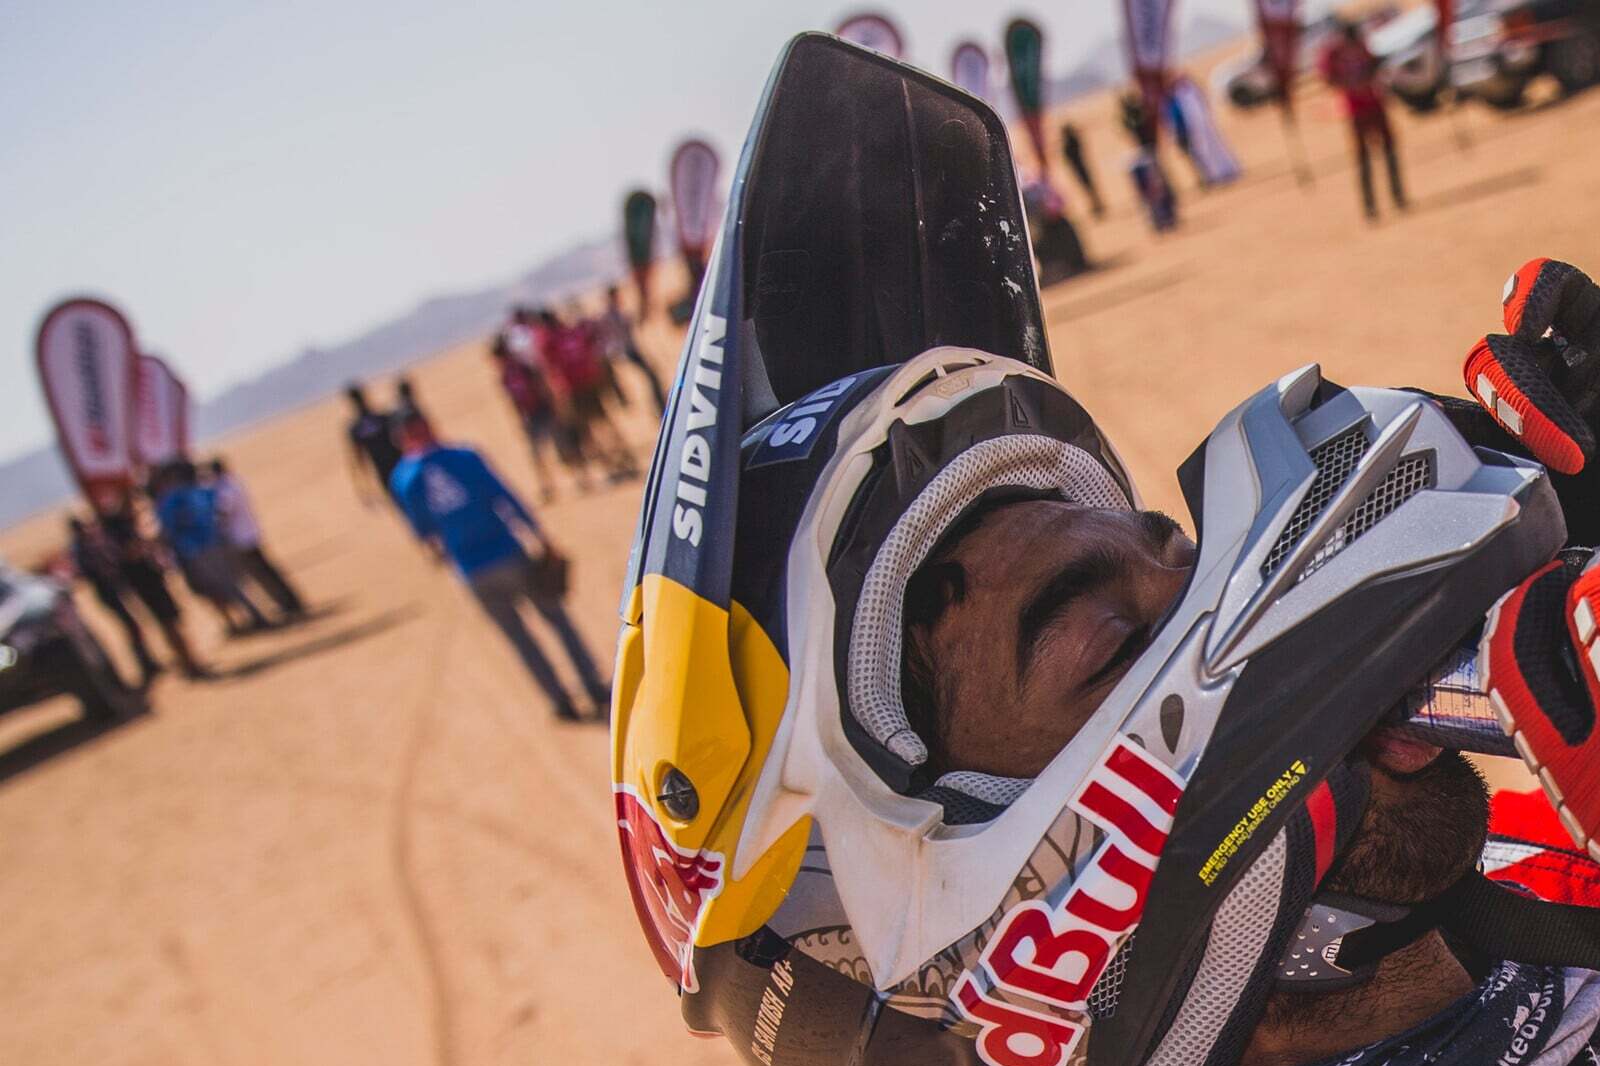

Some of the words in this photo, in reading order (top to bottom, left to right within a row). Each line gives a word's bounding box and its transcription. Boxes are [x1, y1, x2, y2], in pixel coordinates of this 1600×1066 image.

[673, 313, 728, 548] SIDVIN
[1198, 817, 1249, 881] EMERGENCY
[1247, 796, 1269, 820] USE
[1266, 769, 1293, 799] ONLY
[755, 987, 787, 1052] SANTOSH
[769, 958, 795, 997] AB+
